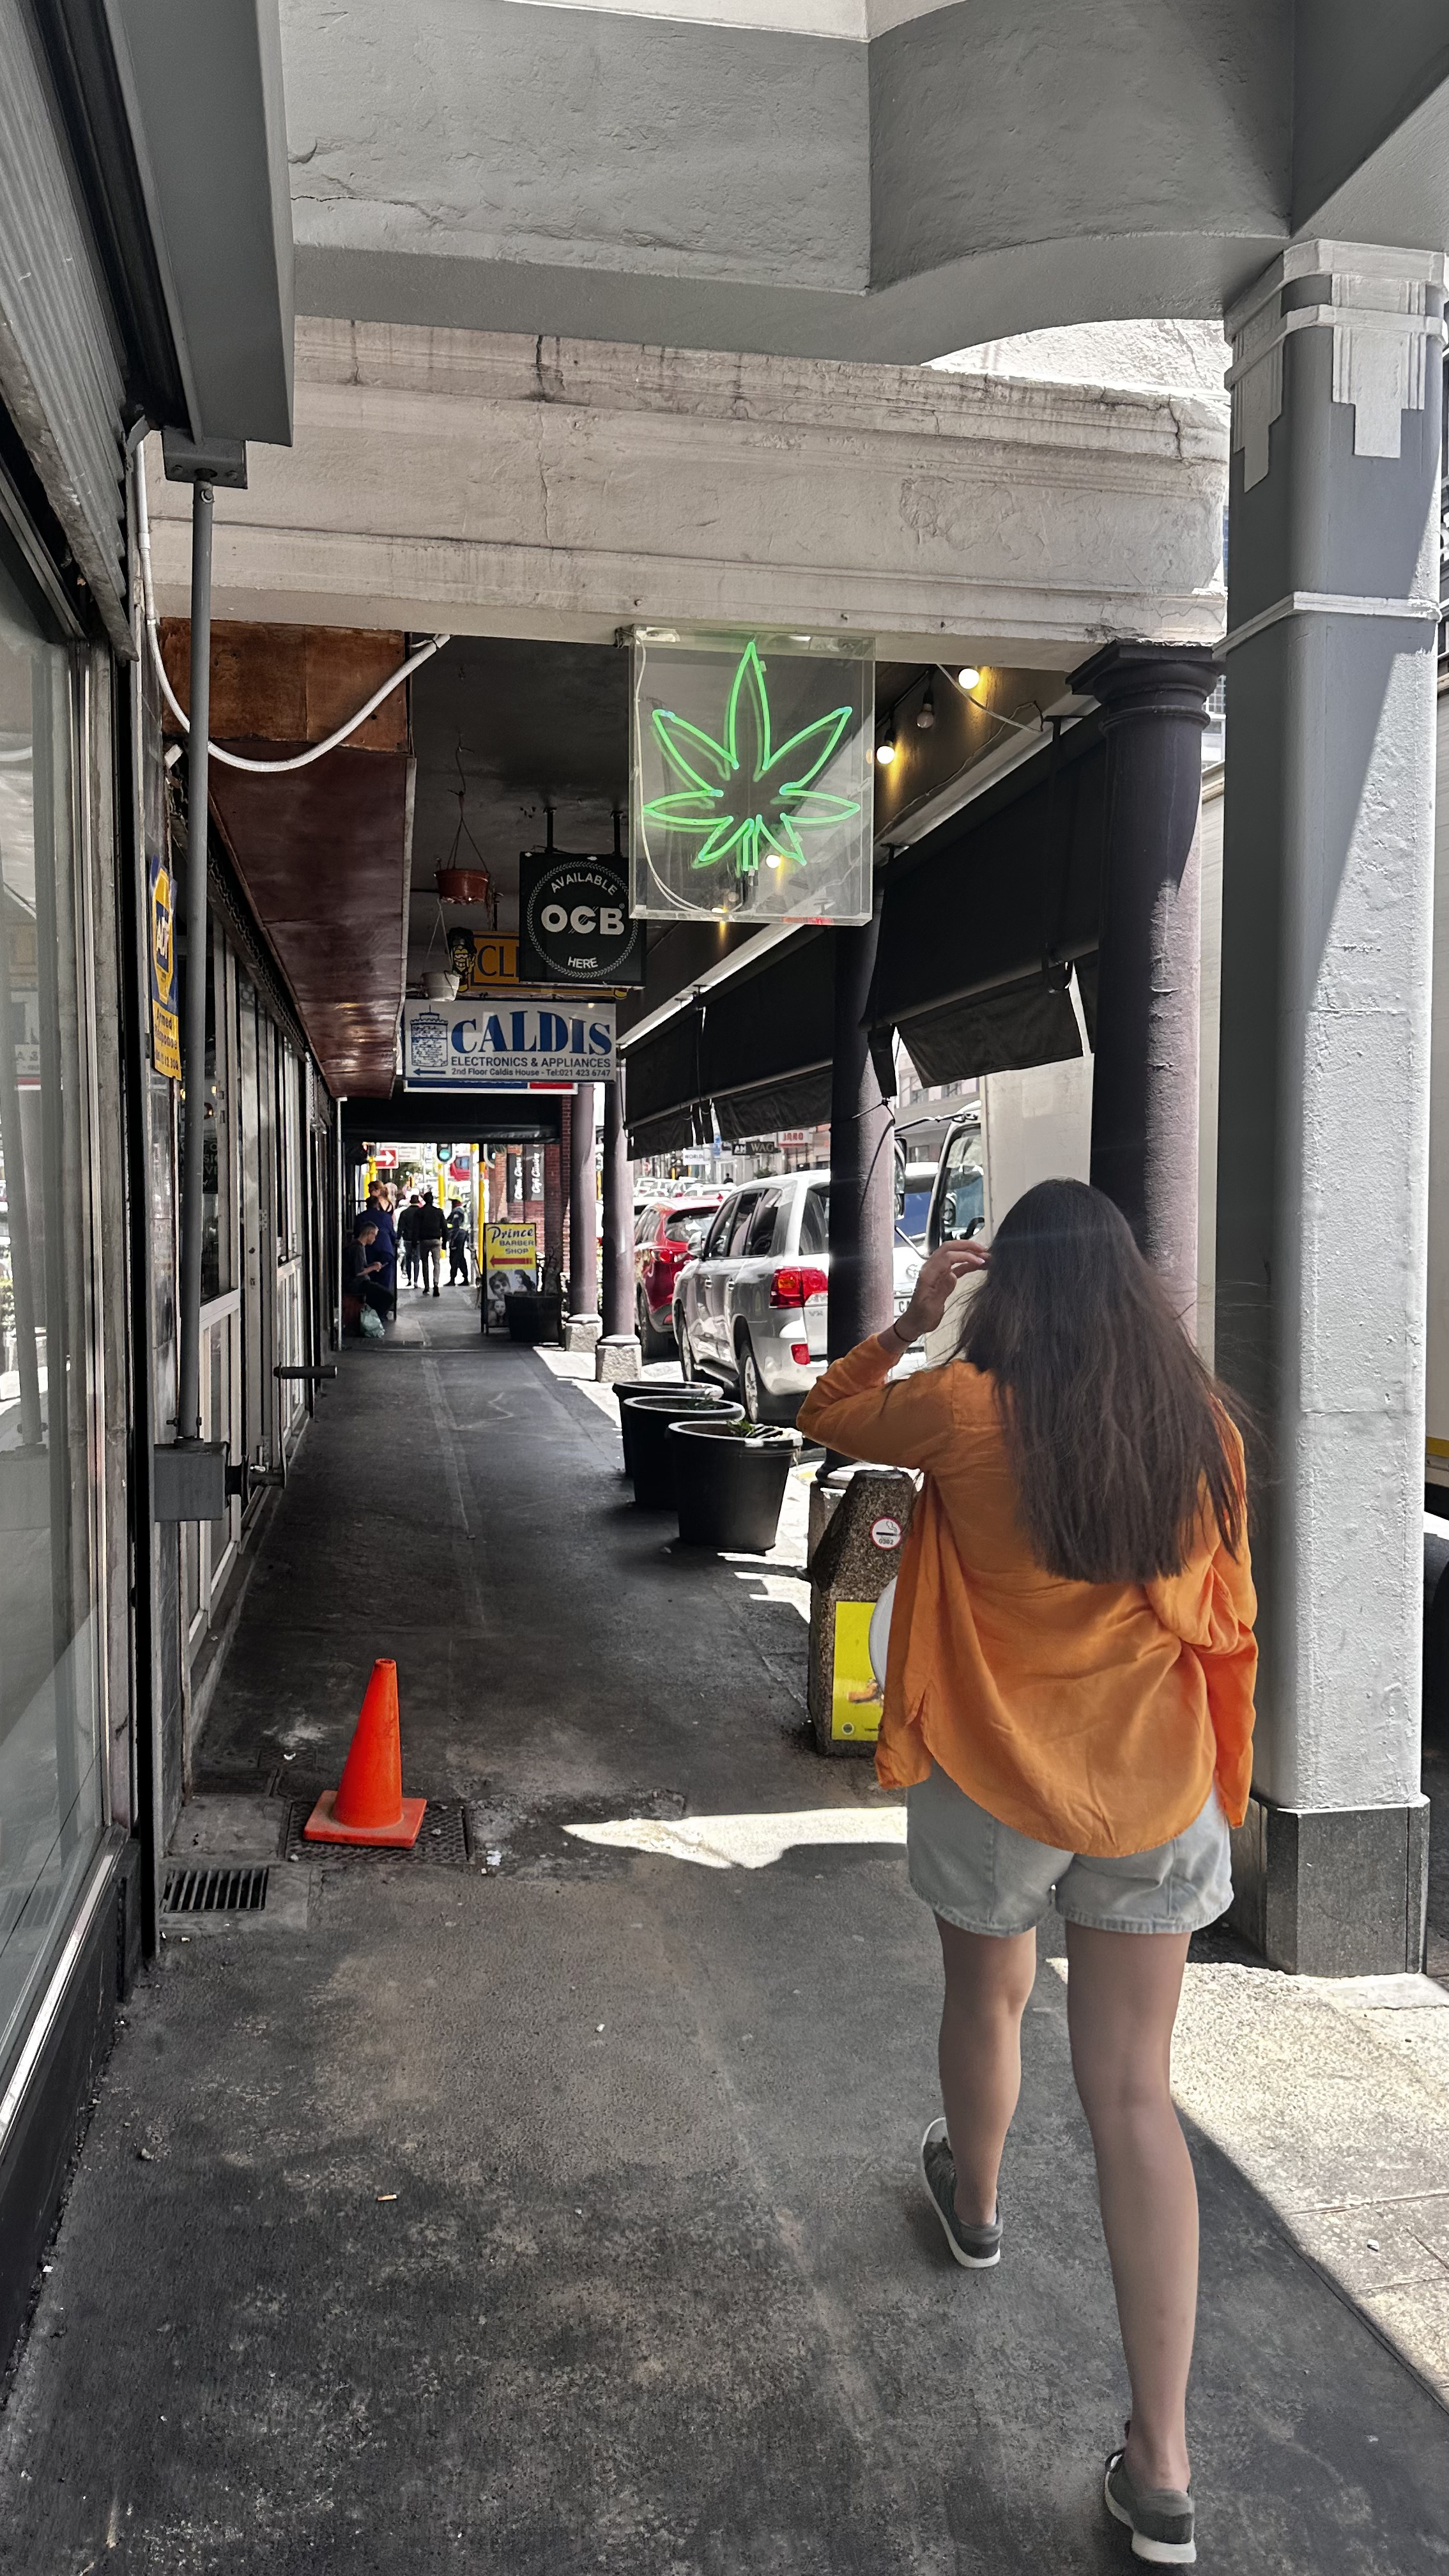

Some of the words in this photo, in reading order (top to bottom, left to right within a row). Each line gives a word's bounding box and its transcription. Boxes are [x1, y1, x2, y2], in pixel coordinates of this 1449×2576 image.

[551, 872, 618, 896] AVAILABLE
[541, 904, 625, 935] OCB
[567, 956, 599, 969] HERE
[451, 1011, 612, 1055] CALDIS
[451, 1056, 528, 1066] ELECTRONICS
[531, 1057, 538, 1067] &
[541, 1057, 611, 1068] APPLIANCES
[489, 1068, 514, 1076] Caldis
[515, 1068, 539, 1076] House
[487, 1226, 533, 1244] Prince
